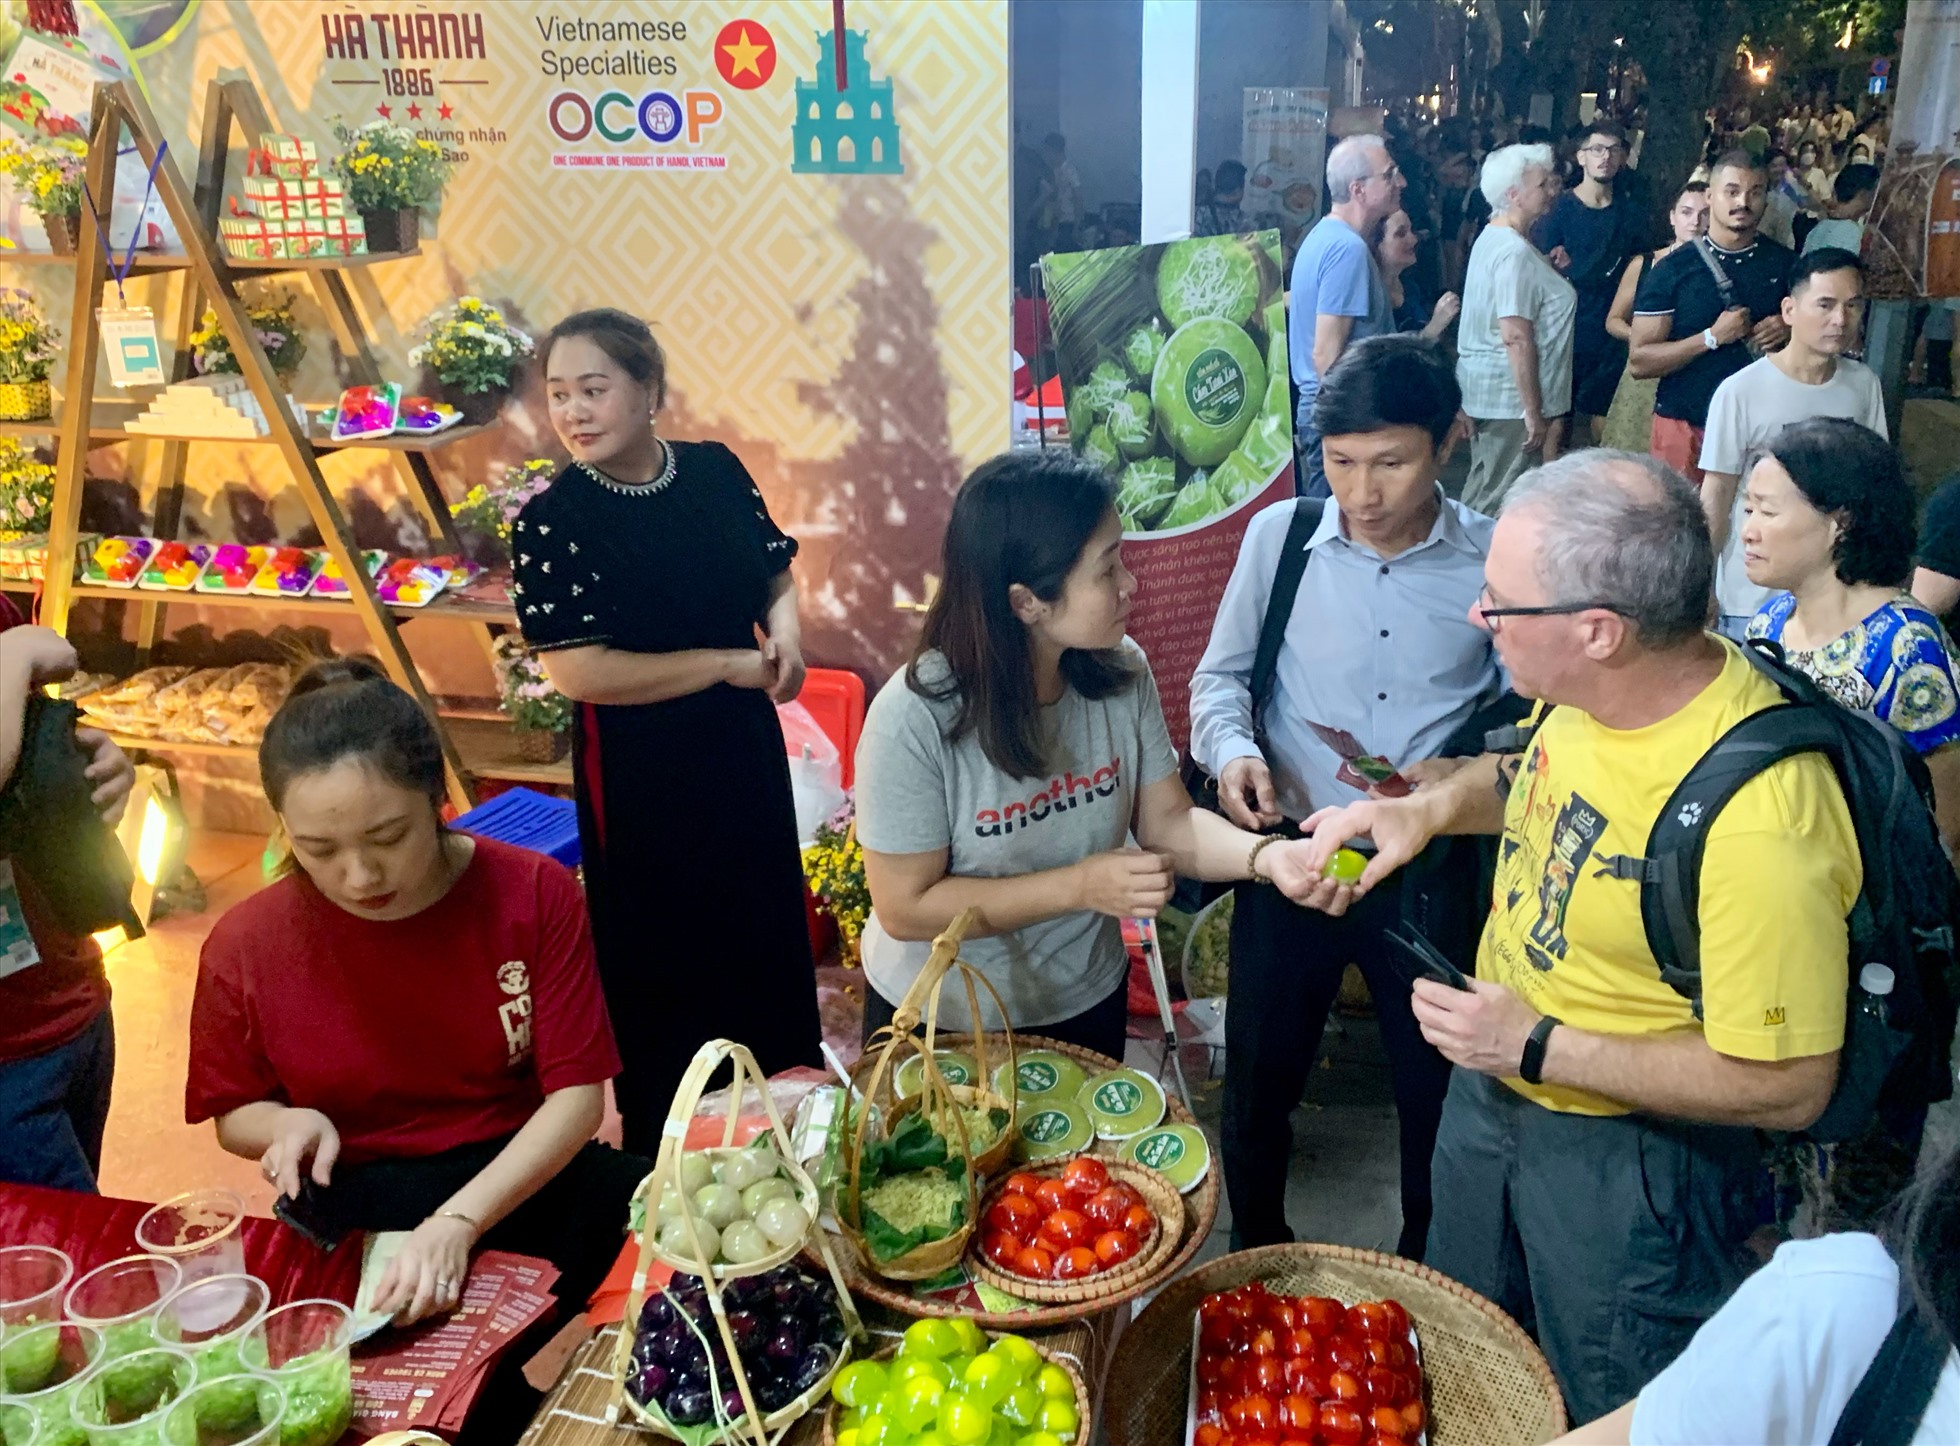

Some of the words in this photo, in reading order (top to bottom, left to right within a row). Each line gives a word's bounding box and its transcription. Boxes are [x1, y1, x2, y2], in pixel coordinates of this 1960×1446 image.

[321, 4, 369, 60] HÀ
[370, 4, 487, 60] THÀNH
[536, 16, 687, 42] Vietnamese
[541, 50, 678, 81] Specialties
[382, 68, 434, 97] 1886
[549, 91, 723, 144] OCOP
[416, 126, 464, 144] chứng
[469, 127, 507, 144] nhận
[441, 149, 470, 162] Sao
[553, 155, 567, 166] ONE
[569, 155, 605, 166] COMMUNE
[606, 155, 620, 166] ONE
[622, 156, 654, 167] PRODUCT
[655, 156, 665, 167] OF
[692, 156, 726, 168] VIETNAM
